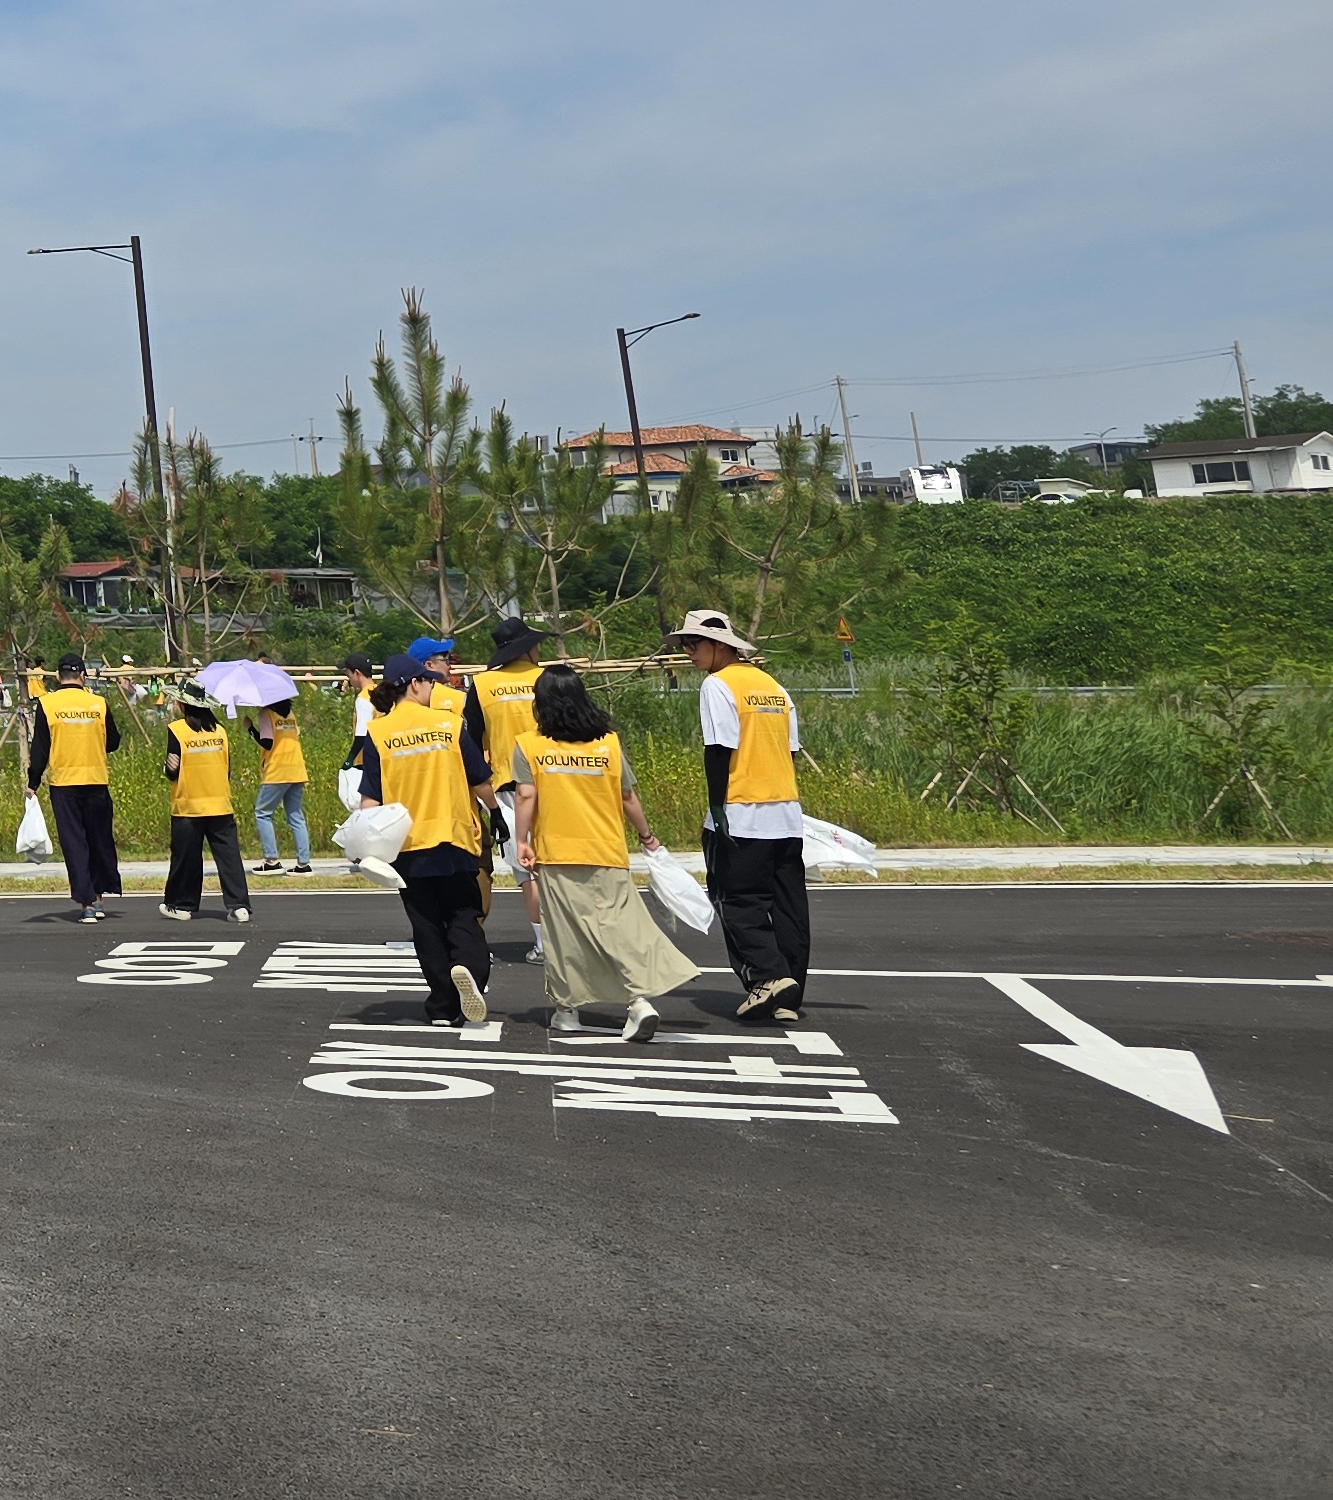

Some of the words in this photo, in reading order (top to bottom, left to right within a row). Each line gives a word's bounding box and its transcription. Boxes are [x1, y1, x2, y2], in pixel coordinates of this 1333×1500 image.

[490, 685, 535, 698] VOLUNT
[55, 711, 101, 720] VOLUNTEER
[184, 738, 225, 749] VOLUNTEER
[383, 731, 454, 750] VOLUNTEER
[535, 755, 610, 769] VOLUNTEER
